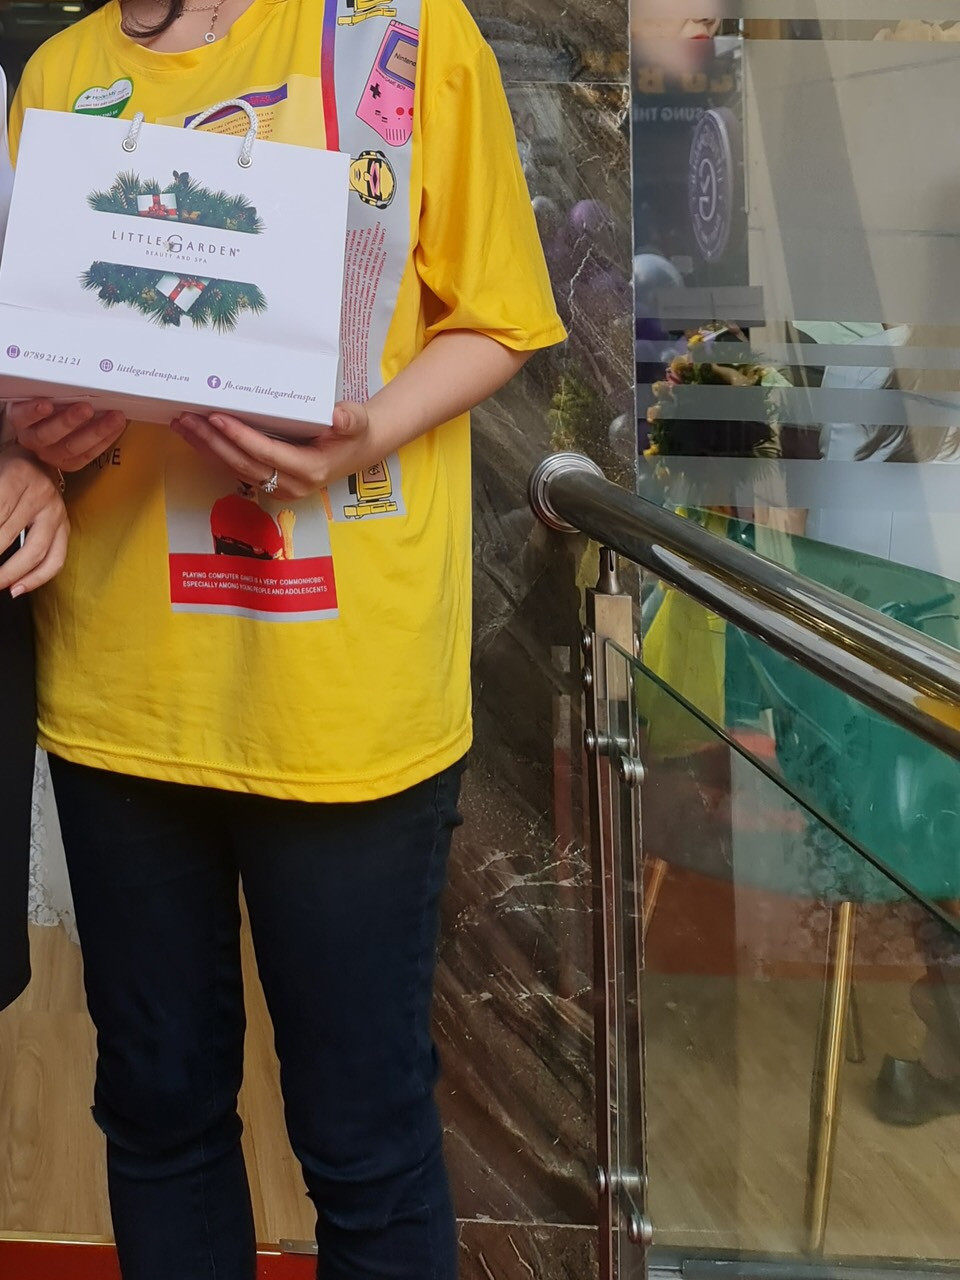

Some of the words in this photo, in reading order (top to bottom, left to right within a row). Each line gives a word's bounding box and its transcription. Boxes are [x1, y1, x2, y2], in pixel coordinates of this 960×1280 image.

[112, 230, 161, 246] LITTLE
[146, 250, 172, 259] BEAUTY
[24, 350, 44, 360] 0789
[46, 354, 56, 362] 21
[116, 363, 190, 382] littlegardenspa.vn
[222, 380, 316, 403] fb.com/littlegardenspa
[284, 586, 328, 595] ADOLESCENTS
